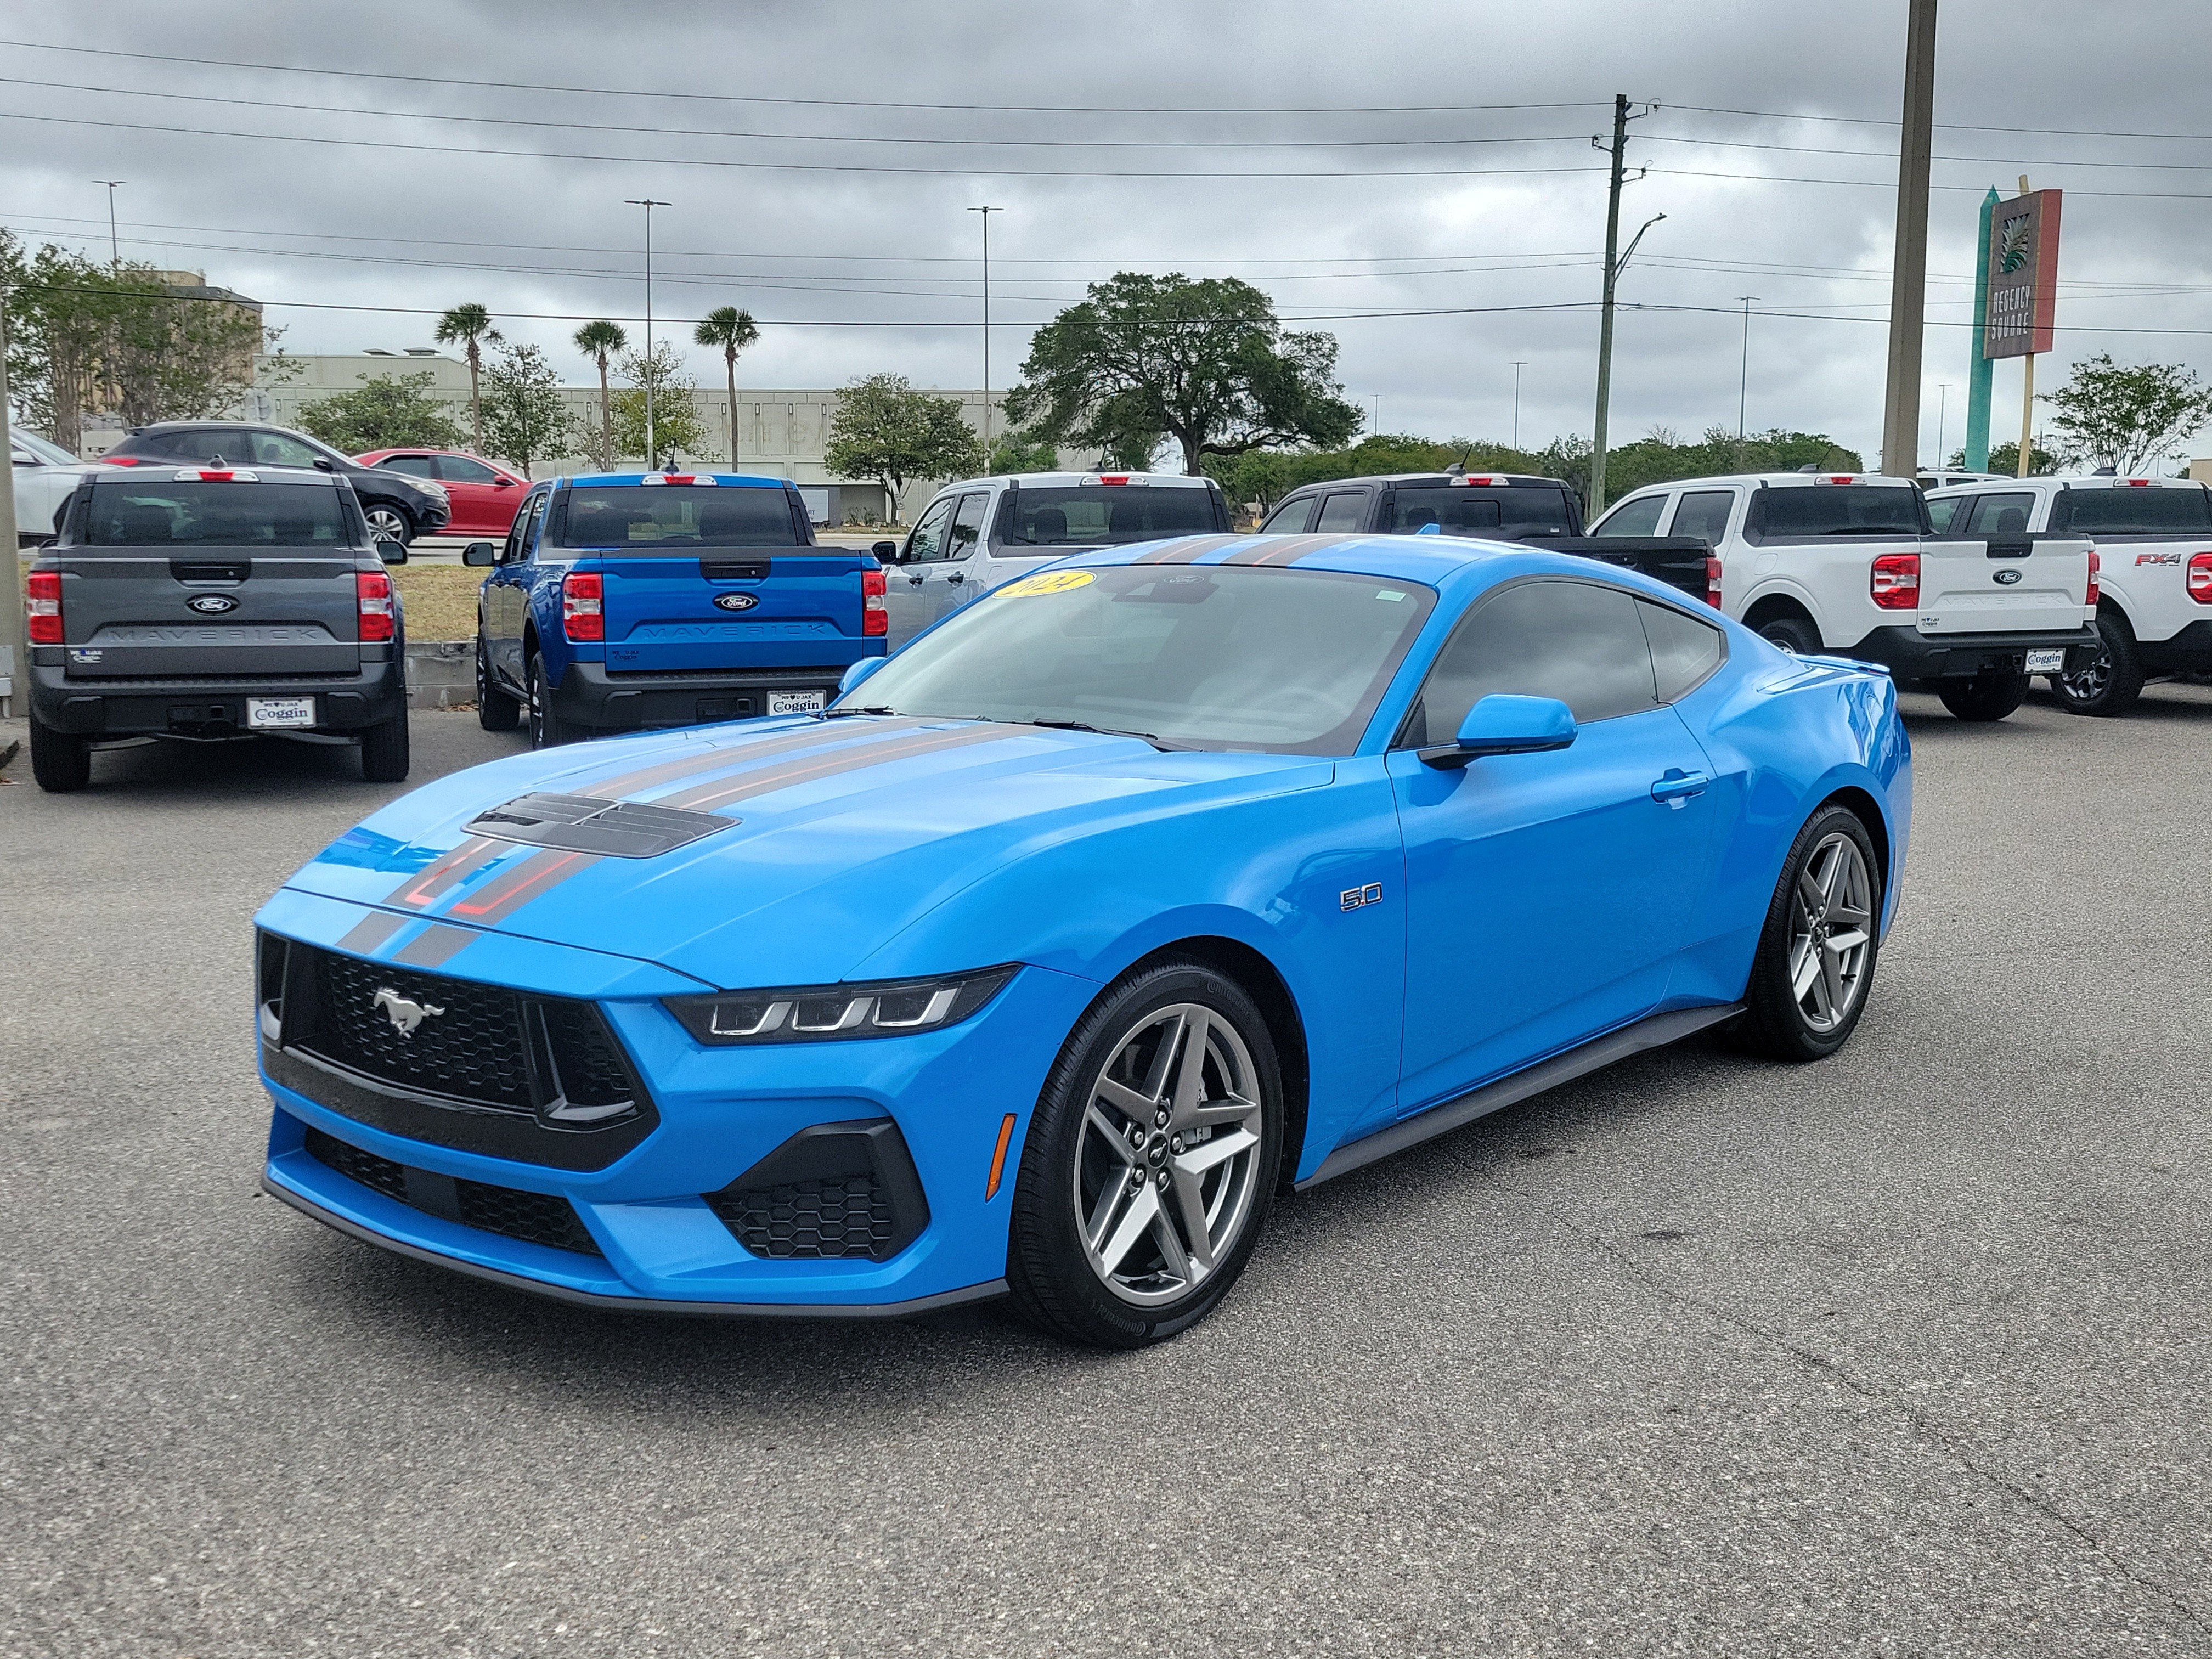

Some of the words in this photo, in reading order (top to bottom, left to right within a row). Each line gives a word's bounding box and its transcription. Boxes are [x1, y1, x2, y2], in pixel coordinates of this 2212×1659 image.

[1993, 285, 2030, 314] REGENCY
[1991, 312, 2029, 341] SQUARE
[2135, 554, 2181, 566] FX4
[1000, 574, 1087, 595] 2024
[109, 629, 317, 642] MAVERICK
[643, 624, 826, 640] MAVERICK
[2028, 653, 2061, 665] Coggin
[255, 708, 308, 720] Coggin
[773, 700, 820, 713] Coggin
[1340, 882, 1383, 912] 5.0
[1096, 1304, 1147, 1336] Continental
